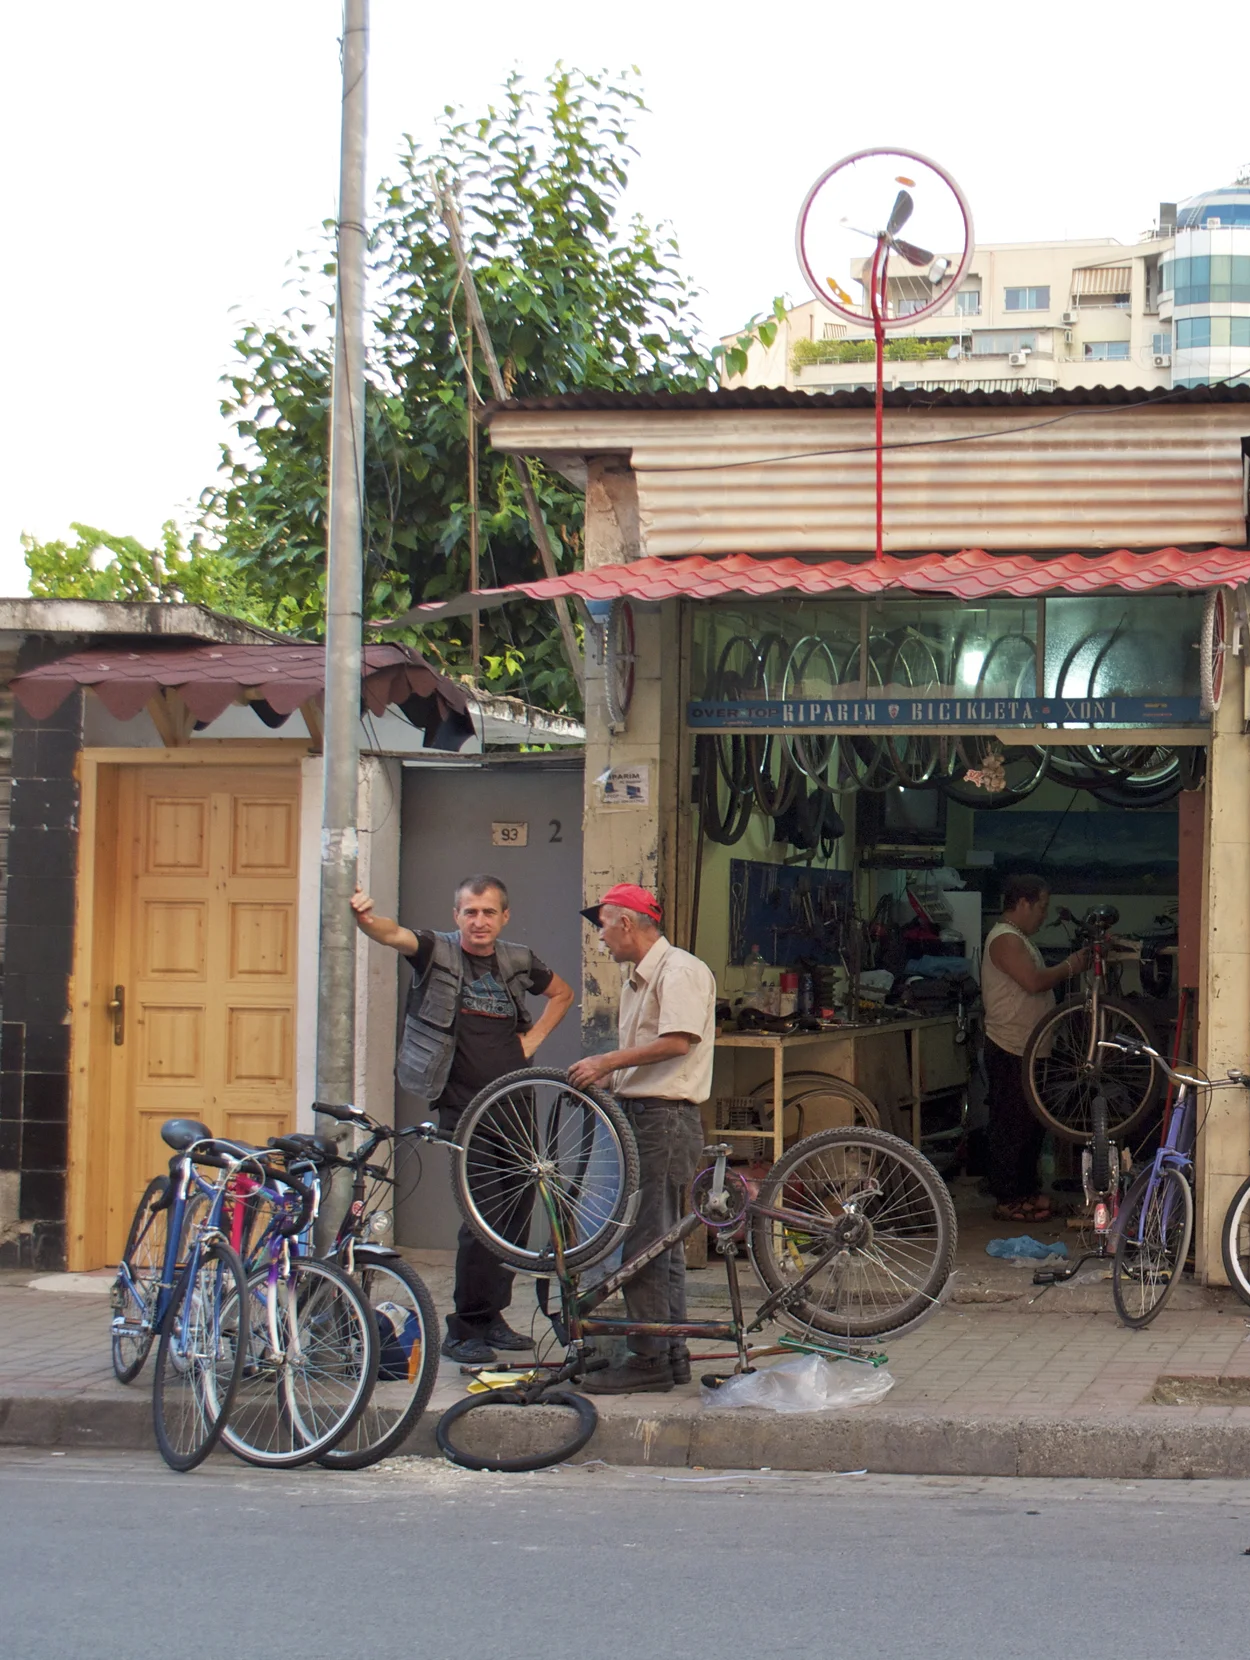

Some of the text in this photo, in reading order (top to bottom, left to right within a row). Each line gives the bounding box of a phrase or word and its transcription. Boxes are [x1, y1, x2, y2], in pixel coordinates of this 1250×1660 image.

[911, 701, 1033, 721] BICIKLETA
[501, 828, 518, 842] 93
[549, 819, 564, 843] 2
